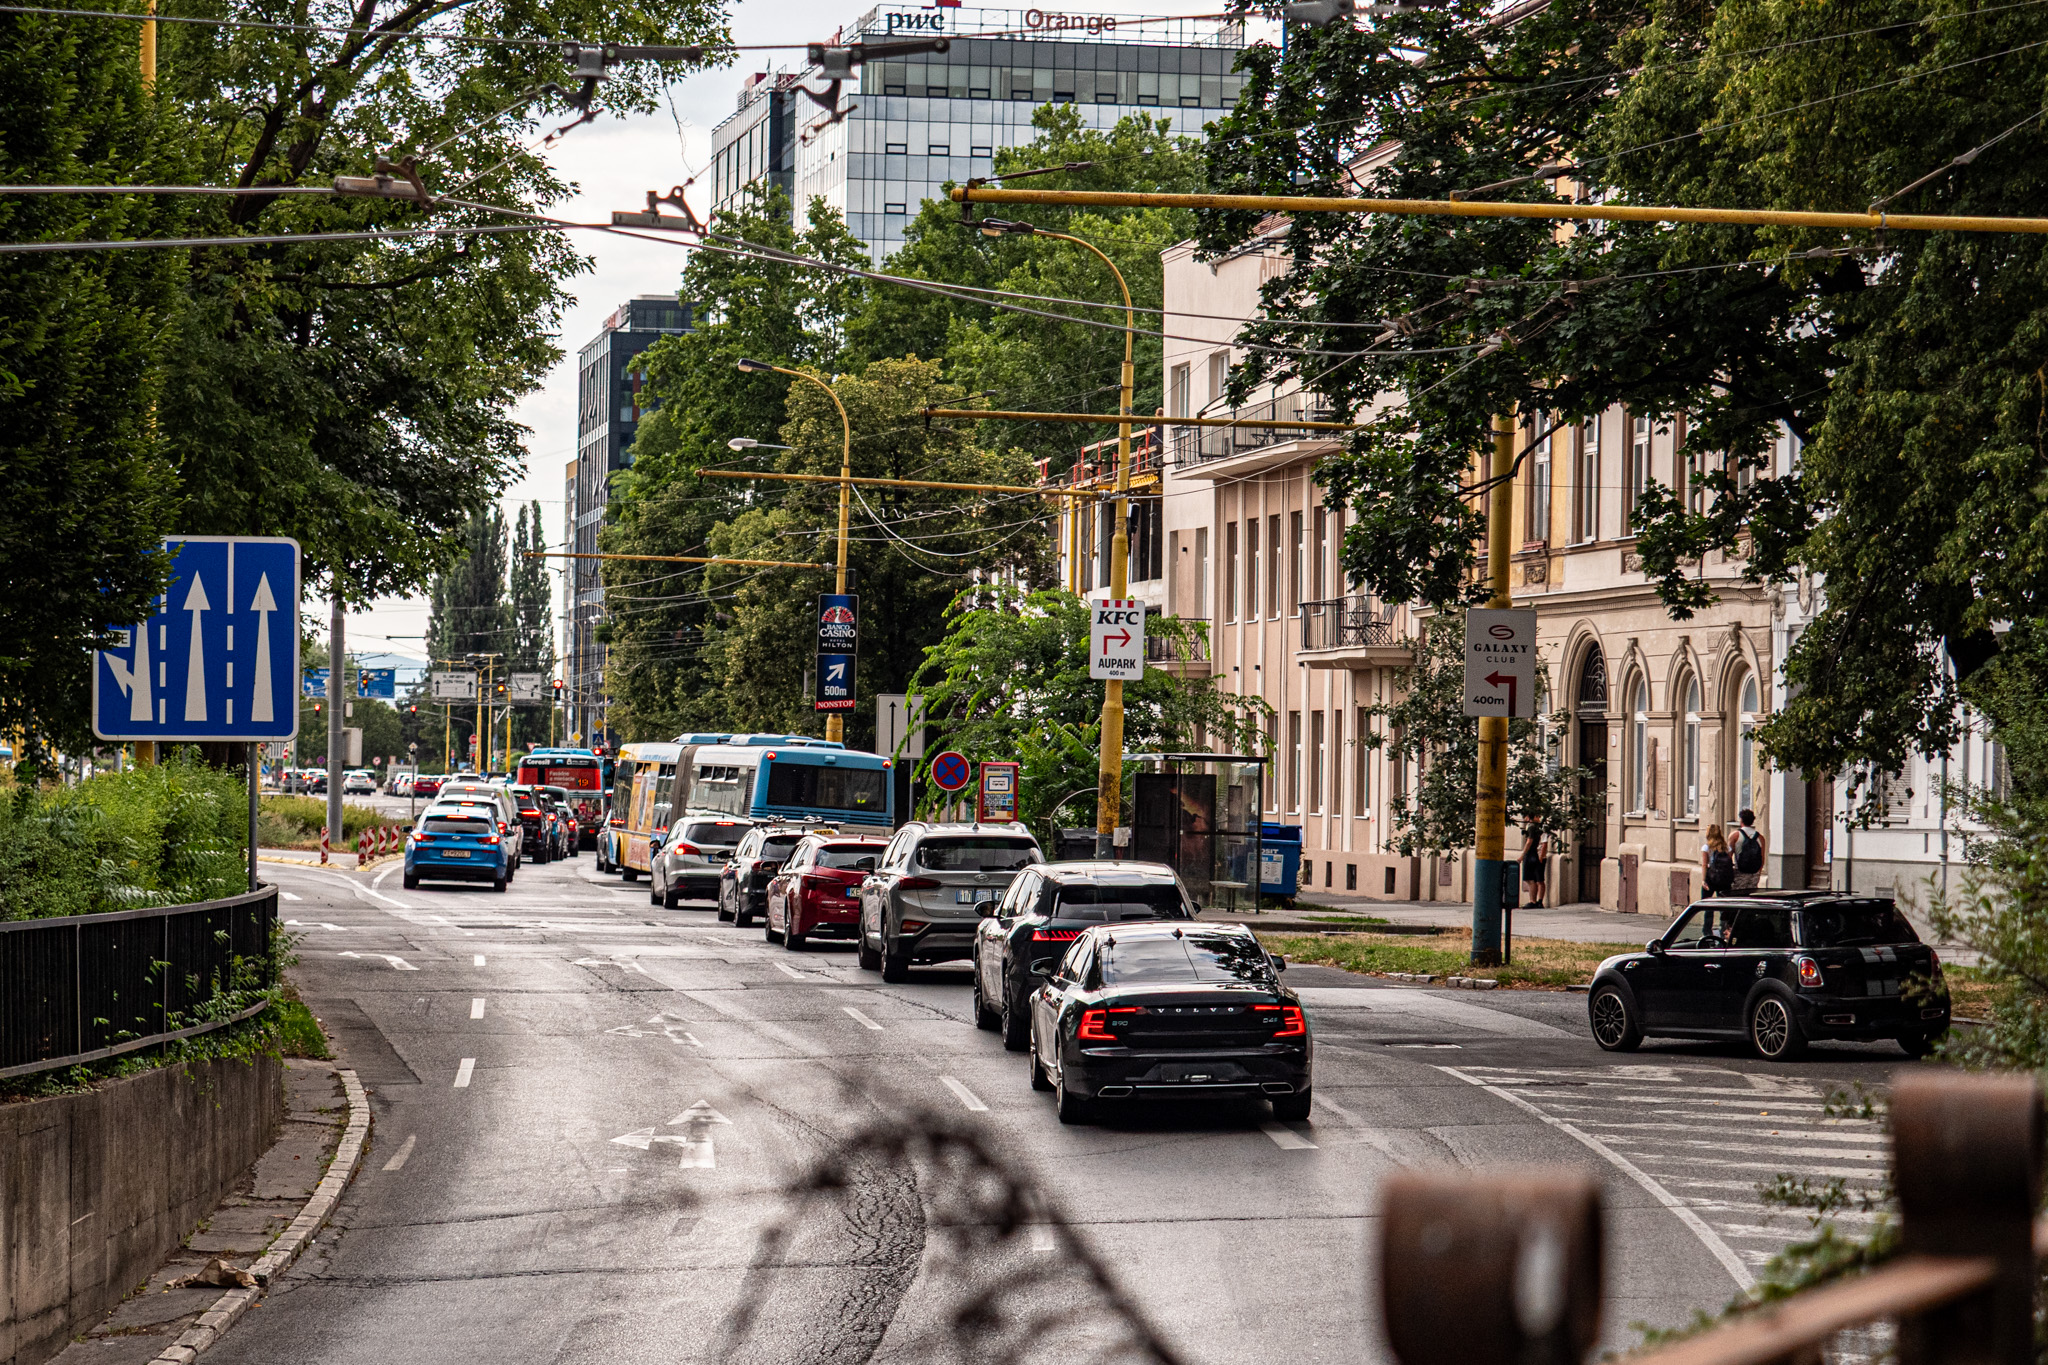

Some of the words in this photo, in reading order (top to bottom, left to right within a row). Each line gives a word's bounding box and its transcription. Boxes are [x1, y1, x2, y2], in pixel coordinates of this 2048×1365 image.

[885, 12, 945, 35] pwc
[1025, 9, 1117, 35] Orange
[1096, 611, 1139, 625] KFC
[820, 629, 856, 638] CASINO
[1473, 643, 1528, 653] GALAXY
[1098, 658, 1136, 669] AUPARK
[824, 685, 847, 696] 500m
[818, 700, 854, 709] NONSTOP
[1472, 695, 1505, 705] 400m
[577, 778, 588, 787] 19
[850, 888, 860, 897] KE
